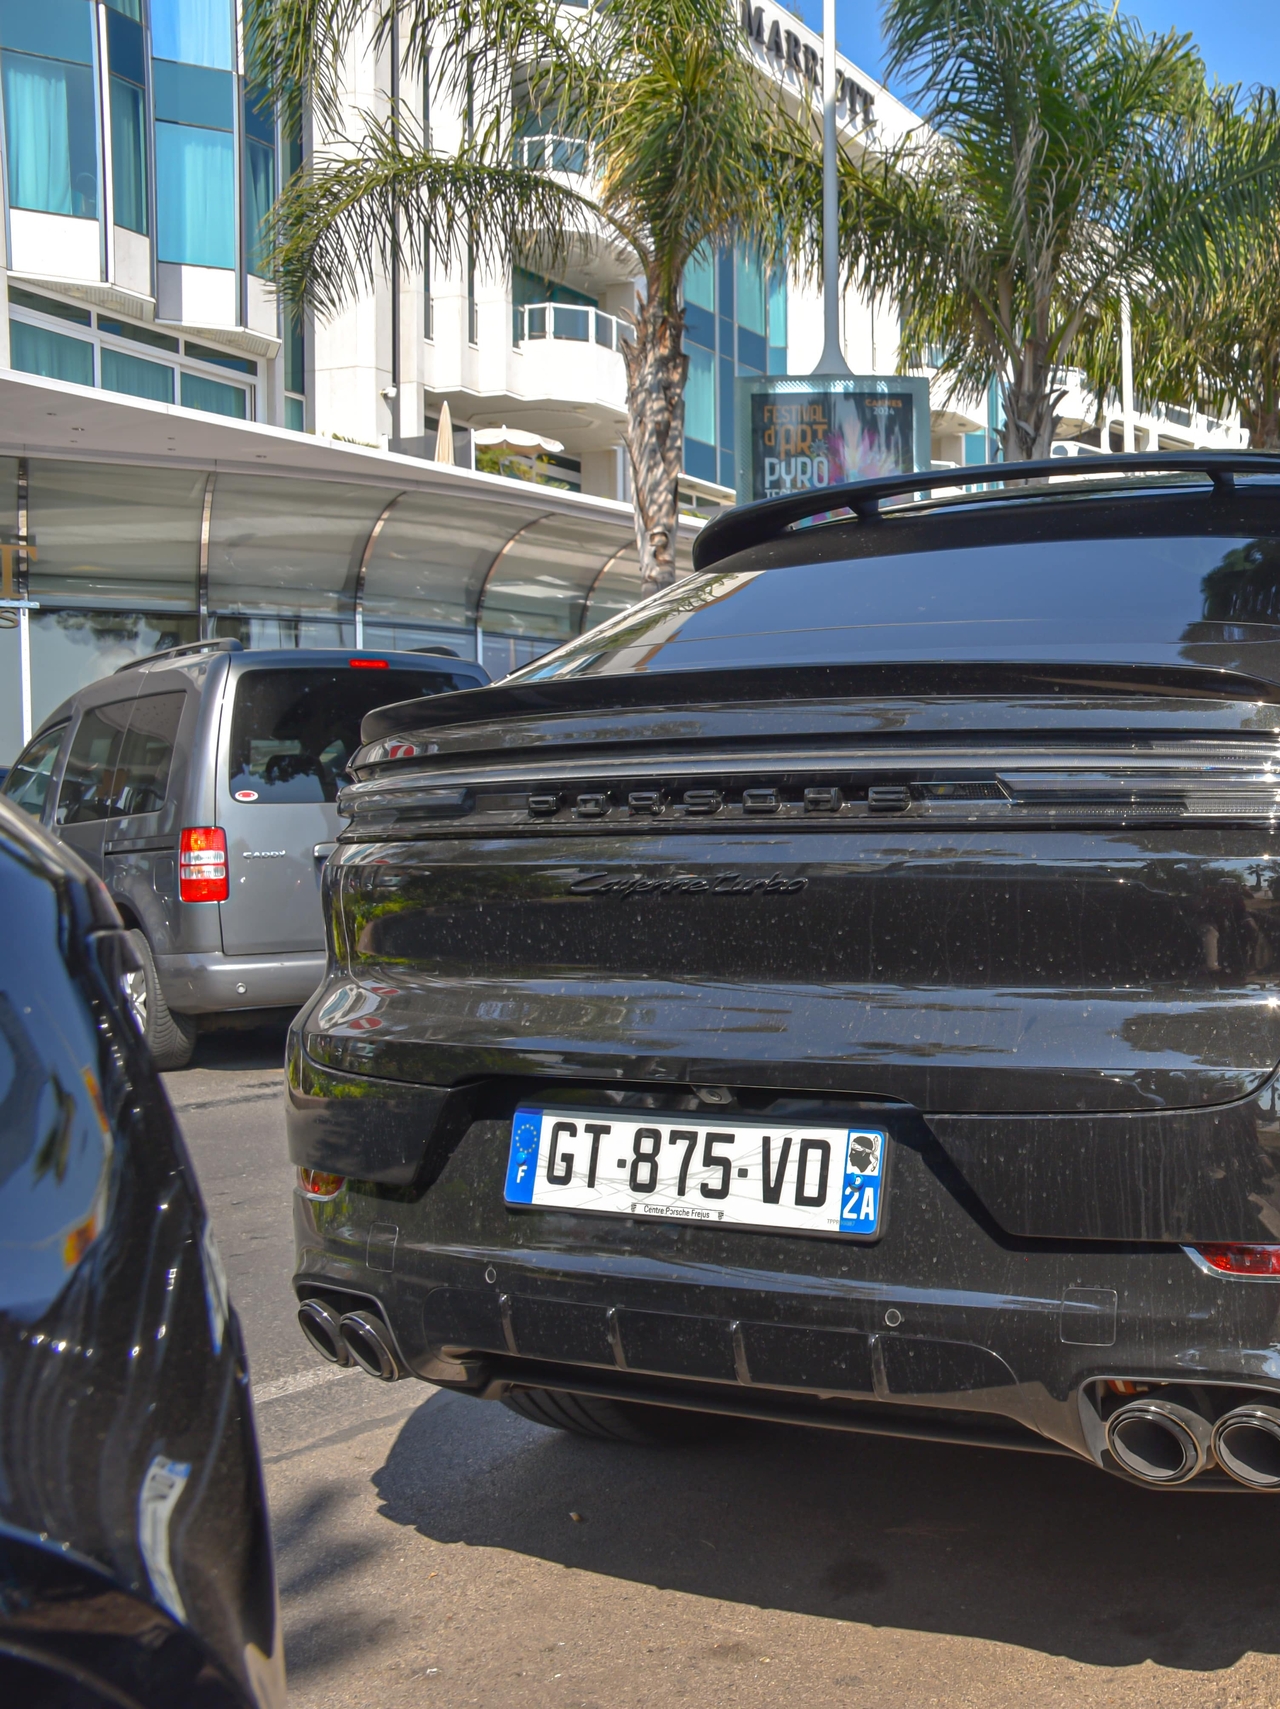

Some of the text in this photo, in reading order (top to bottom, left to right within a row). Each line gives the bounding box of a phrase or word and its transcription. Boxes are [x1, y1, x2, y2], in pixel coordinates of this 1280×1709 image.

[741, 0, 878, 128] MARROTT
[865, 399, 903, 408] CANNES
[873, 407, 896, 415] 2024
[763, 404, 828, 424] FESTIVAL
[764, 456, 830, 489] PYRO
[527, 785, 911, 817] PORSCHE
[243, 849, 286, 860] CADDY
[568, 871, 710, 902] Cayenne
[515, 1165, 526, 1184] F
[643, 1205, 665, 1215] Centre
[665, 1206, 690, 1217] Porsche
[842, 1185, 875, 1222] 2A
